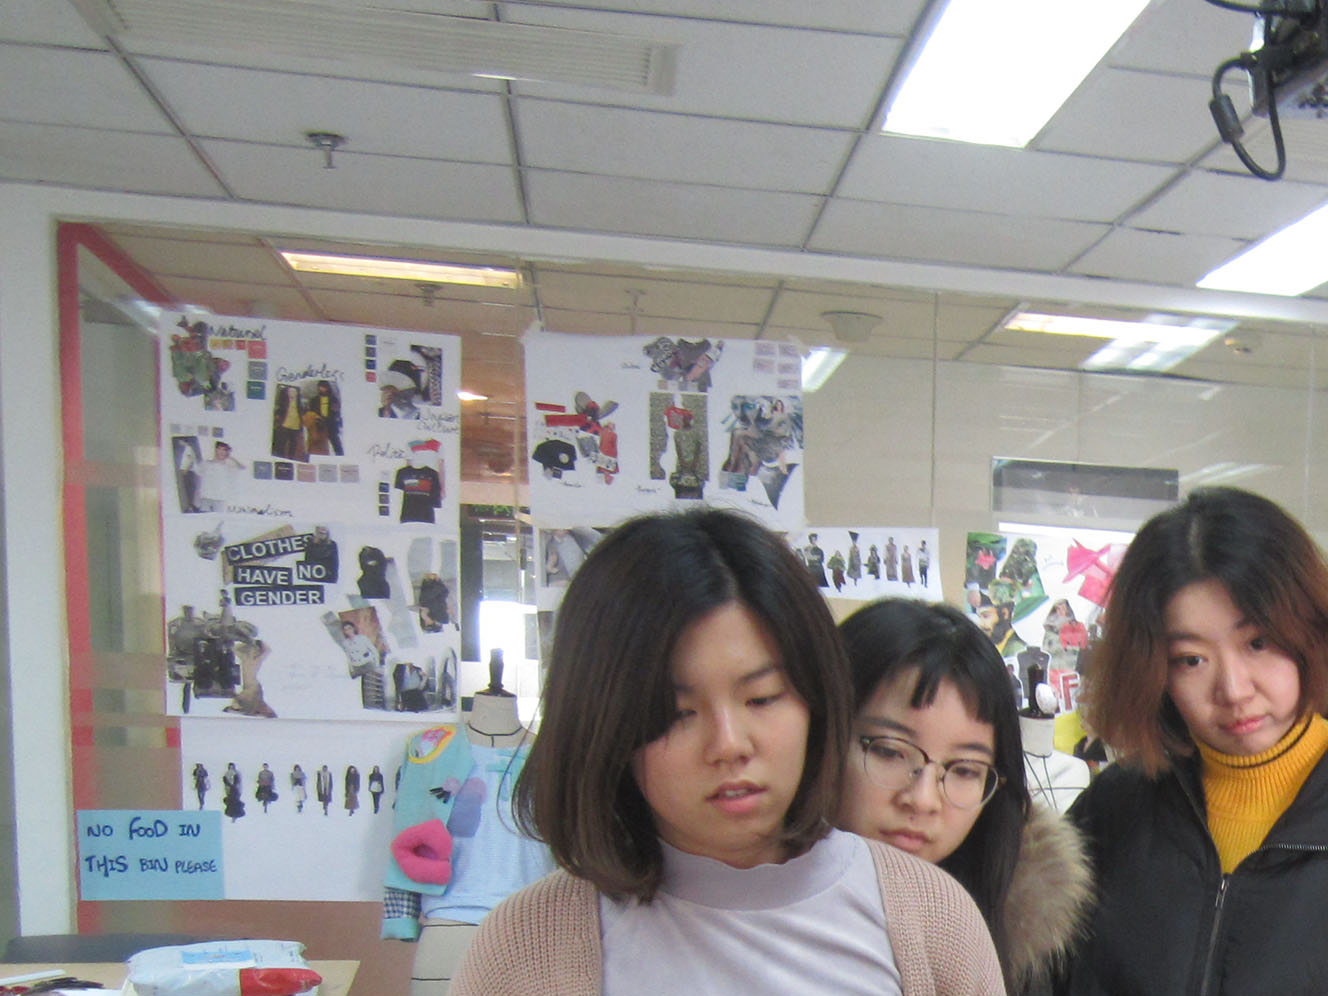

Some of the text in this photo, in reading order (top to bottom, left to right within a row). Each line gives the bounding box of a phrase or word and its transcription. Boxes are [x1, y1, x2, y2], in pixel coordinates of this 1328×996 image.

[226, 535, 314, 561] CLOTHES
[237, 564, 326, 585] HAVE NO
[240, 590, 321, 605] GENDER
[87, 816, 201, 840] NO FOOD IN
[85, 855, 218, 878] THIS BIN PLEASE
